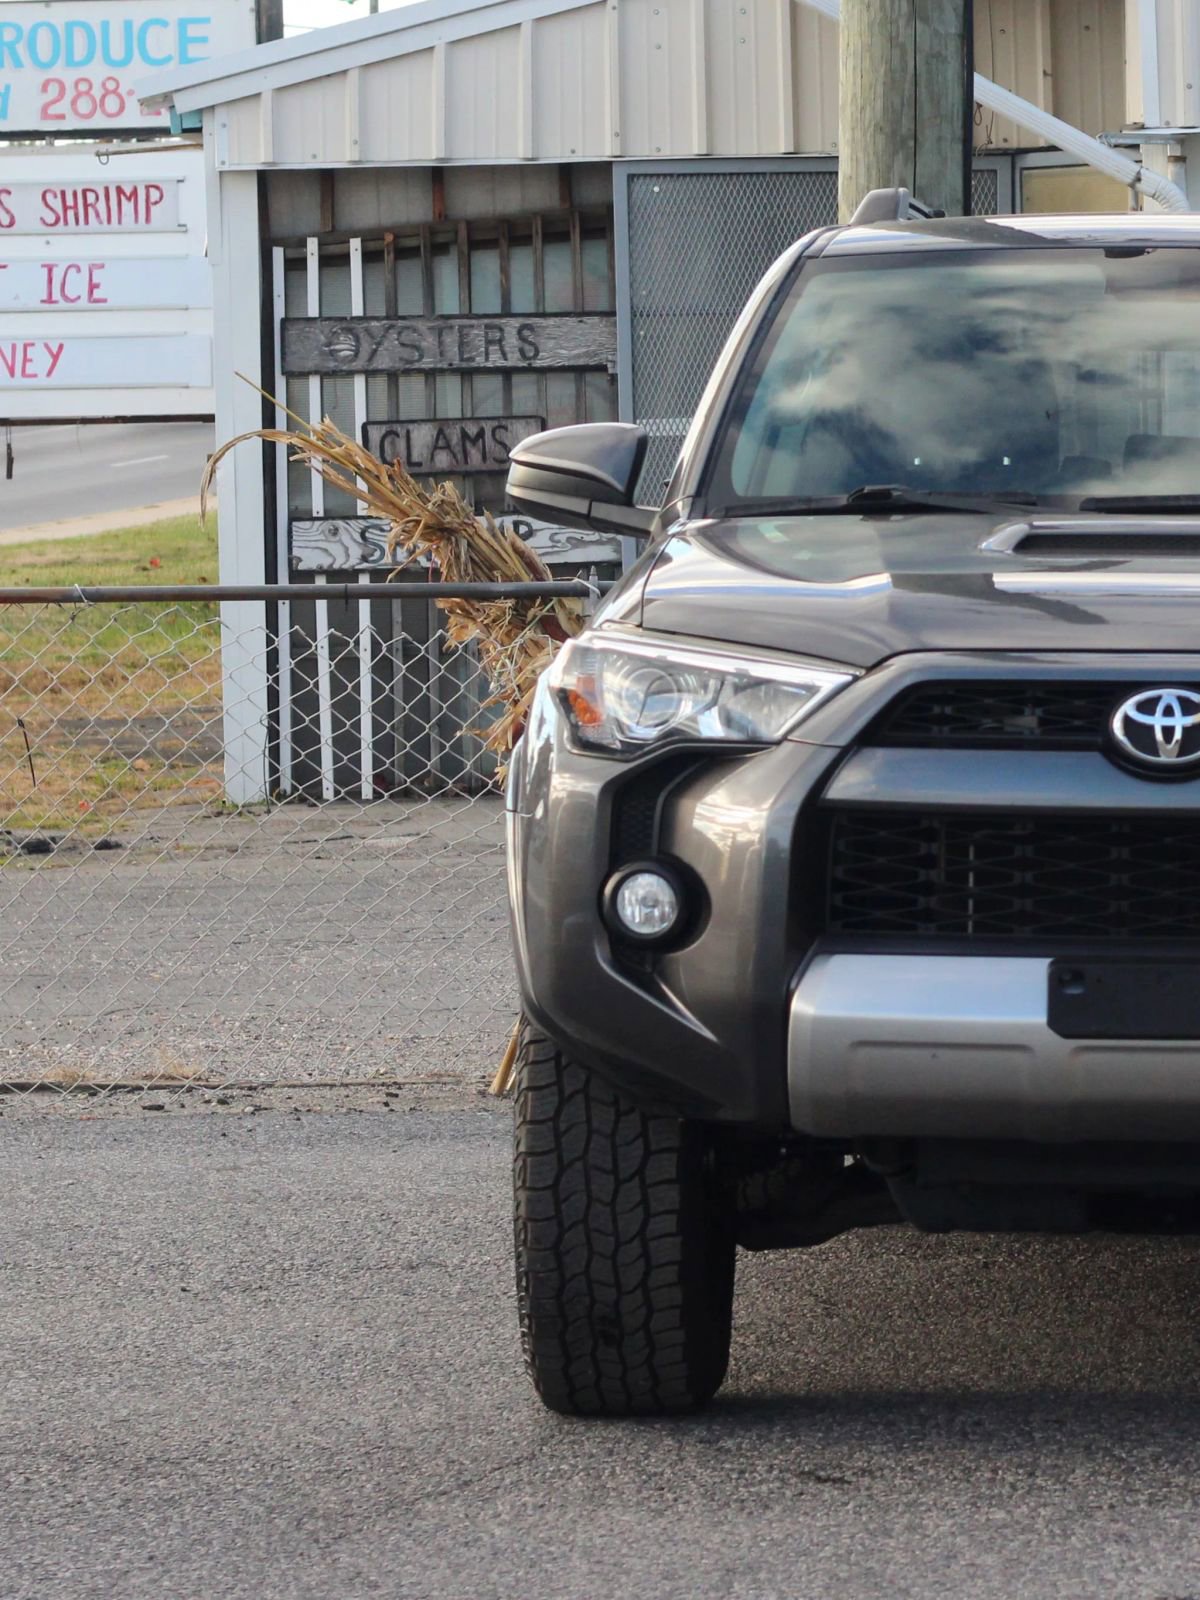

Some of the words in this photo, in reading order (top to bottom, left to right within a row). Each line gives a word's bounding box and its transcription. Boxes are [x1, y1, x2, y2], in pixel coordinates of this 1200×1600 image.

[40, 184, 164, 228] SHRIMP
[39, 263, 108, 304] ICE
[324, 323, 540, 365] OYSTERS
[379, 425, 511, 467] CLAMS
